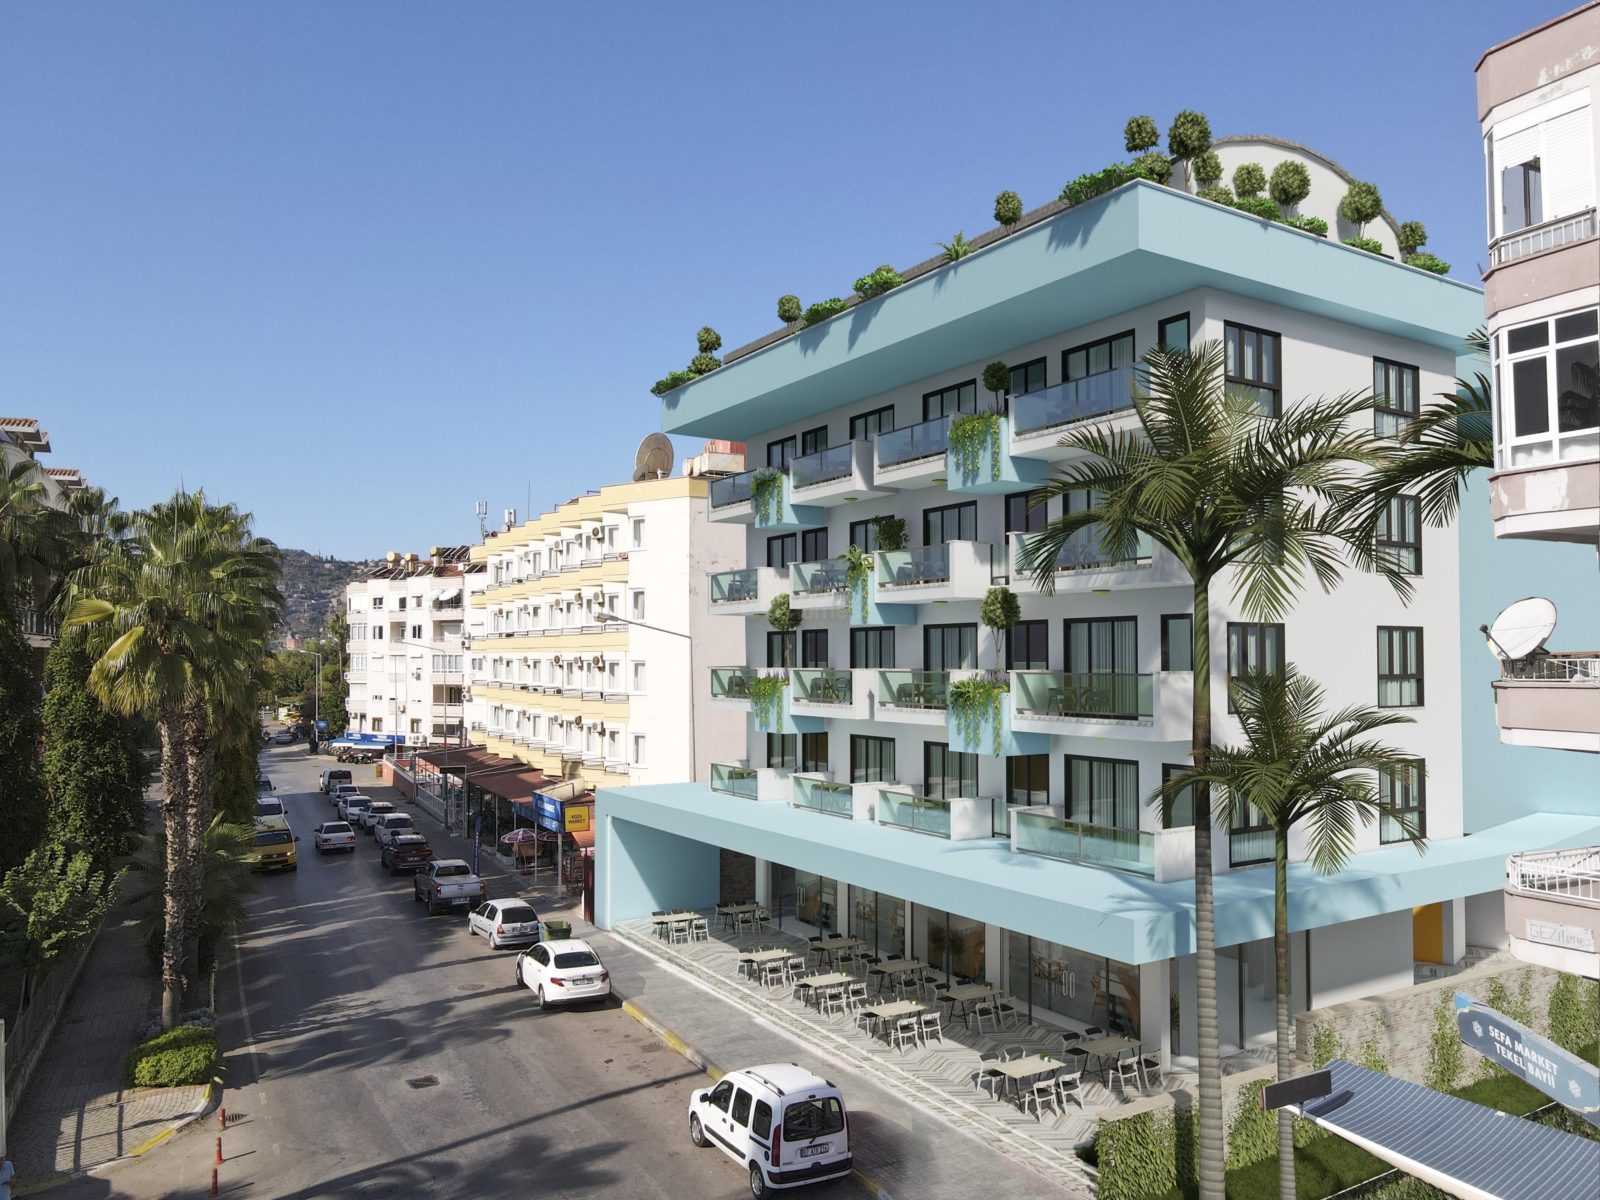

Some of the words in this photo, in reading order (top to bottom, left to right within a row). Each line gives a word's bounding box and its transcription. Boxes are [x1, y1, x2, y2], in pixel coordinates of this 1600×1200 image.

[1488, 1025, 1513, 1048] SEFA
[1514, 1040, 1558, 1075] MARKET
[1494, 1041, 1526, 1071] TEKEL
